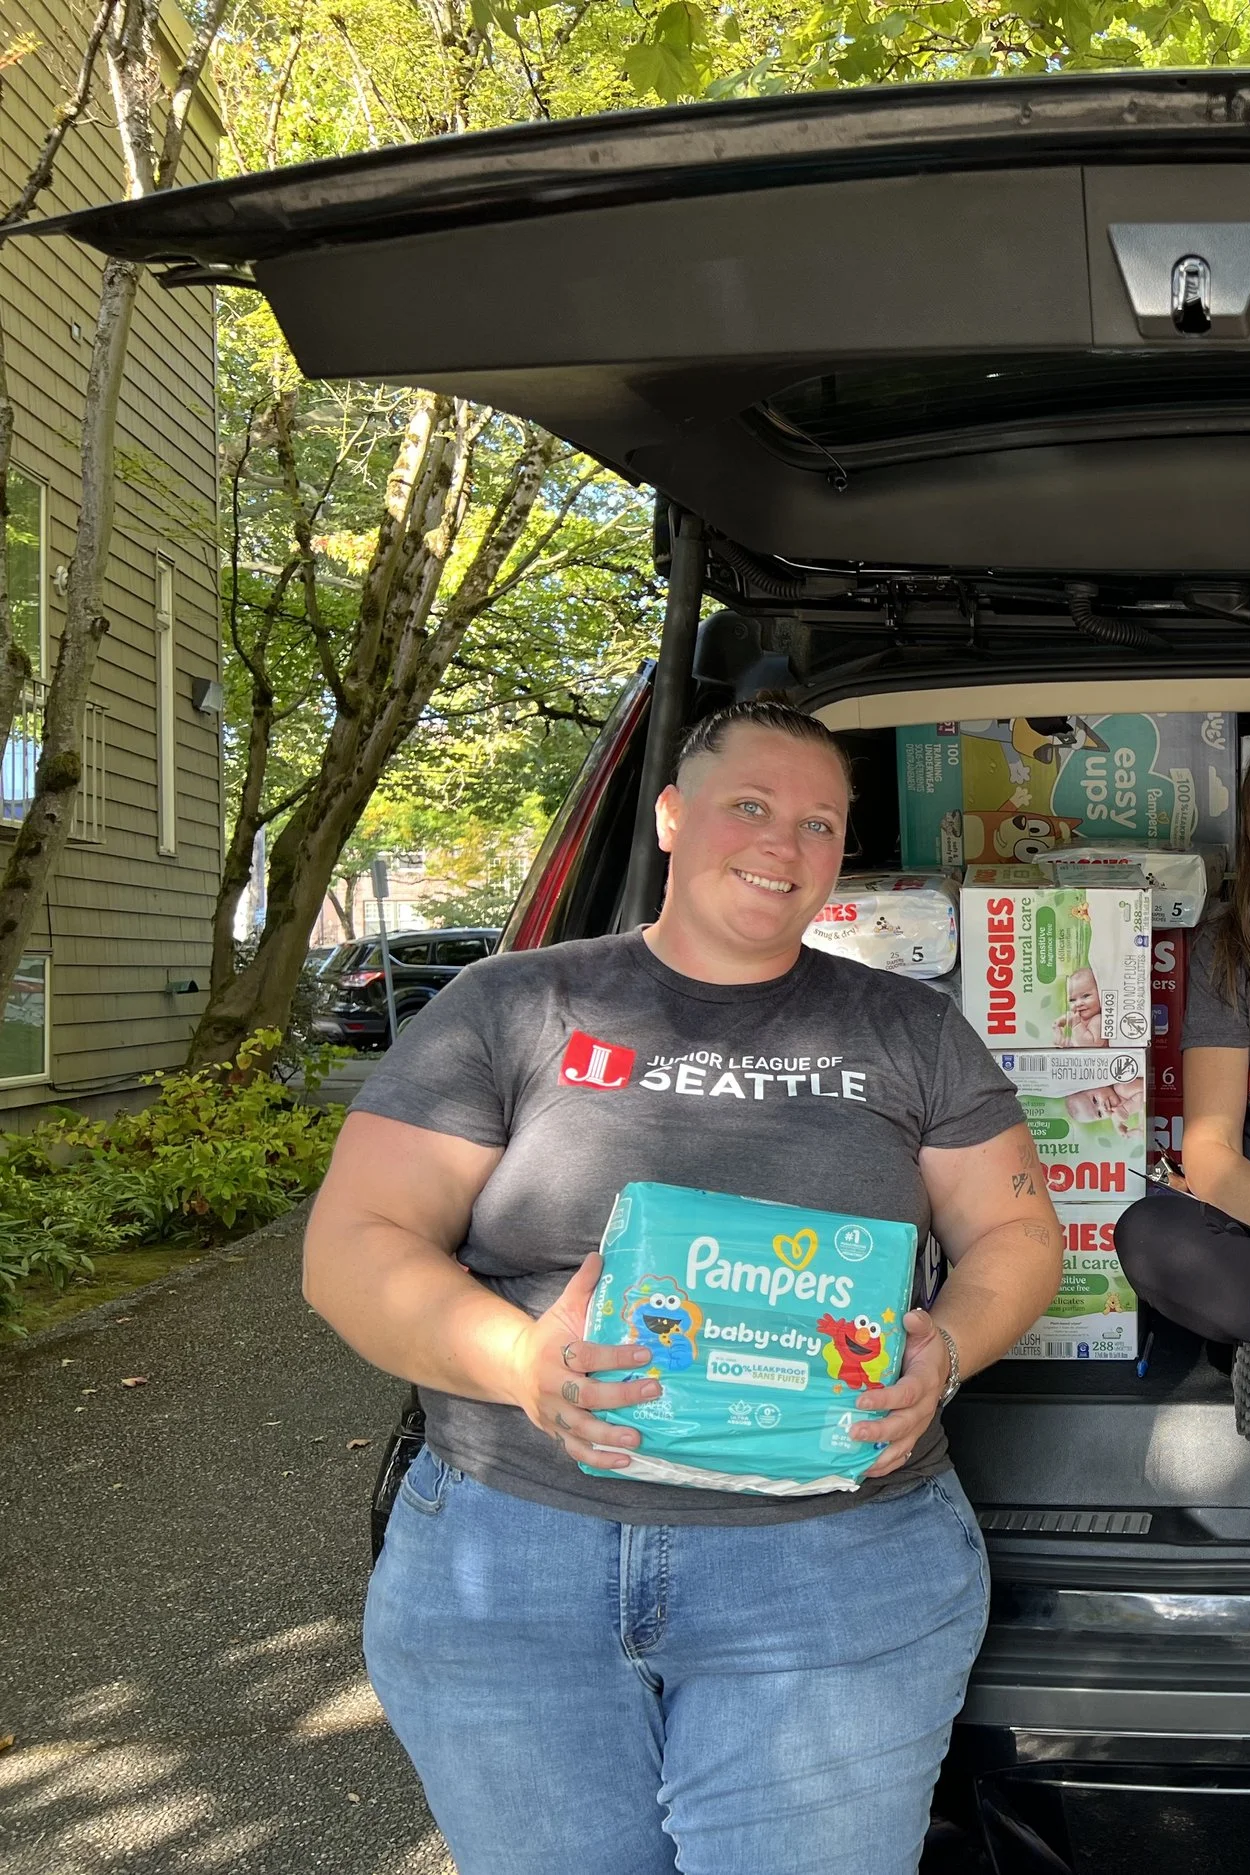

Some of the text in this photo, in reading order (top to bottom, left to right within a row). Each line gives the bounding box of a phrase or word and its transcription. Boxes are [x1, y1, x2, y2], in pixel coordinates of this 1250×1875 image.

[934, 743, 942, 782] TRAINING
[948, 743, 959, 766] 100
[925, 743, 934, 794] UNDERWEAR
[1080, 756, 1108, 821] ups
[1113, 747, 1137, 829] easy
[1147, 788, 1162, 840] Pampers
[1172, 902, 1182, 917] 5
[1133, 910, 1142, 933] 288
[813, 928, 833, 941] snug
[834, 931, 840, 939] &
[1019, 897, 1034, 993] natural care
[912, 946, 924, 962] 5
[1046, 938, 1054, 967] fragrance
[986, 897, 1017, 1035] HUGGIES
[1124, 954, 1136, 1011] DO NOT FLUSH
[646, 1050, 843, 1071] JUNIOR LEAGUE OF
[1051, 1058, 1109, 1067] PAS AUX TOILETTES
[638, 1062, 867, 1102] SEATTLE
[1051, 1067, 1109, 1080] DO NOT FLUSH
[1162, 1067, 1175, 1085] 6
[1040, 1143, 1079, 1156] natu
[1042, 1161, 1125, 1192] HUG
[844, 1229, 860, 1244] #1
[685, 1235, 855, 1309] Pampers
[1081, 1259, 1119, 1270] care
[1076, 1284, 1090, 1292] free
[594, 1274, 613, 1332] Pampers
[1092, 1341, 1113, 1351] 288
[752, 1364, 806, 1376] LEAKPROOF
[752, 1372, 806, 1385] SANS FUITES
[838, 1411, 852, 1433] 4
